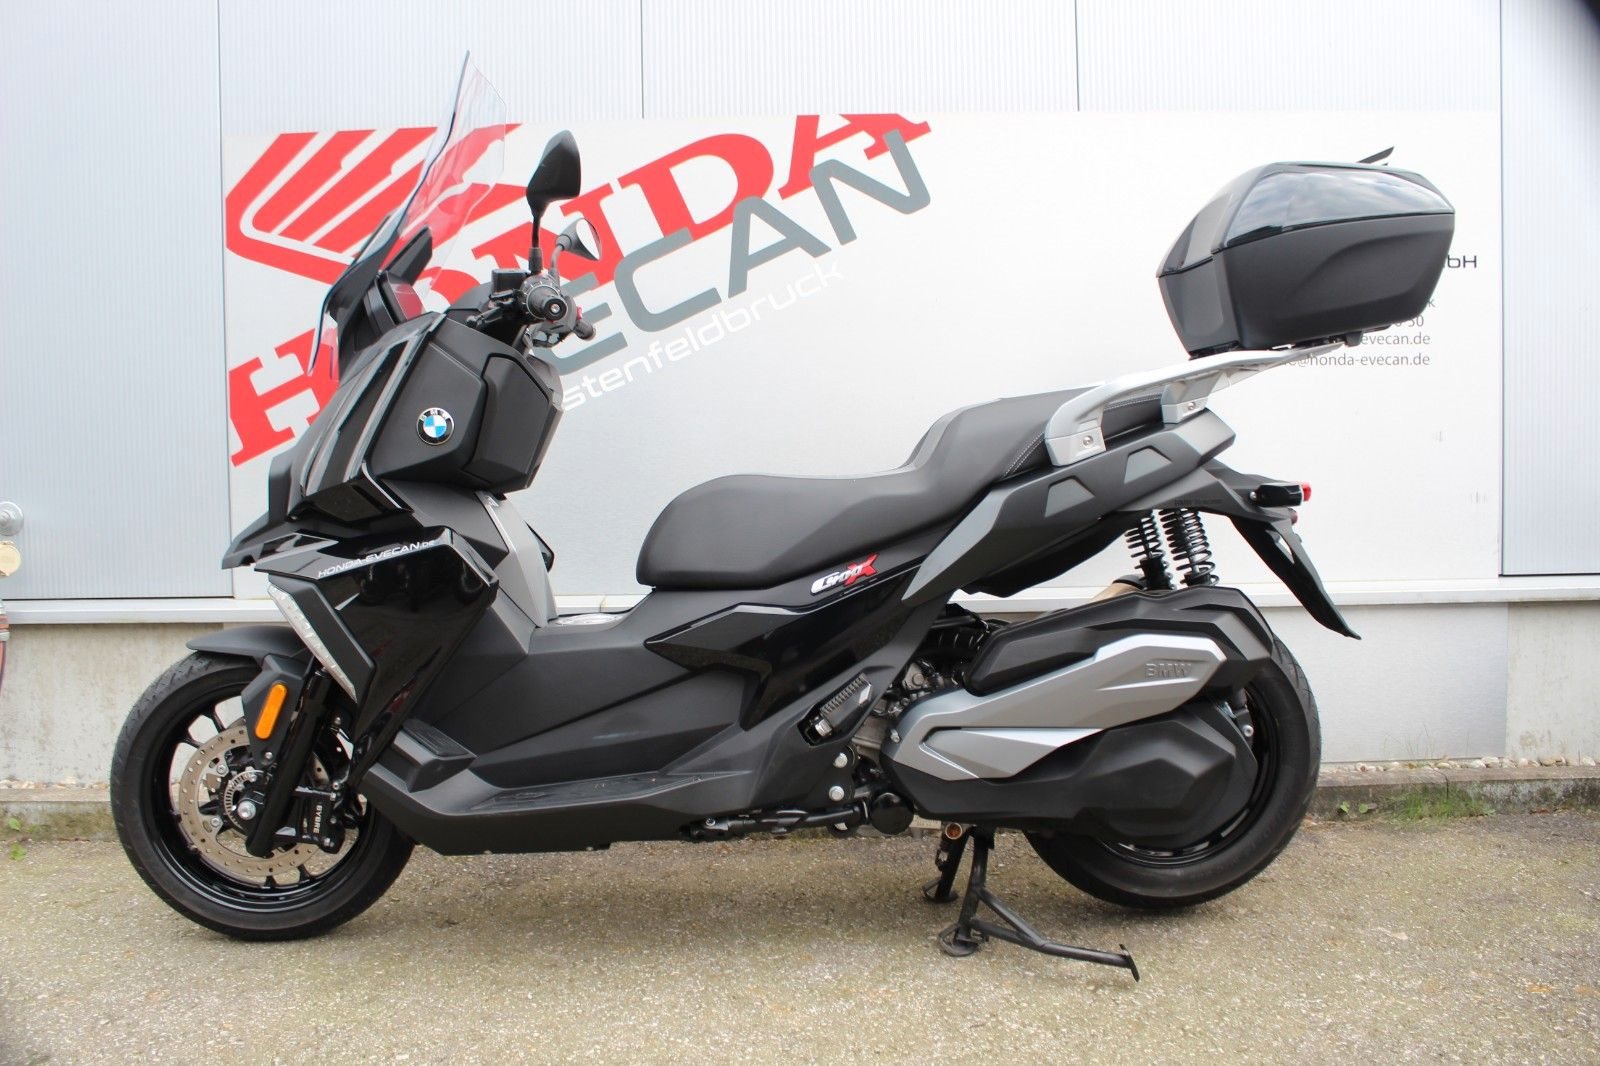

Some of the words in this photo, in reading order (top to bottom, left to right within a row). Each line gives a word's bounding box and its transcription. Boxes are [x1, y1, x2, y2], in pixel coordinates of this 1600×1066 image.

[228, 113, 931, 467] HNDA
[532, 129, 932, 376] ECAN
[564, 261, 845, 412] stenfeldbruck
[1361, 332, 1431, 345] evecan.de
[1144, 663, 1192, 679] BMW
